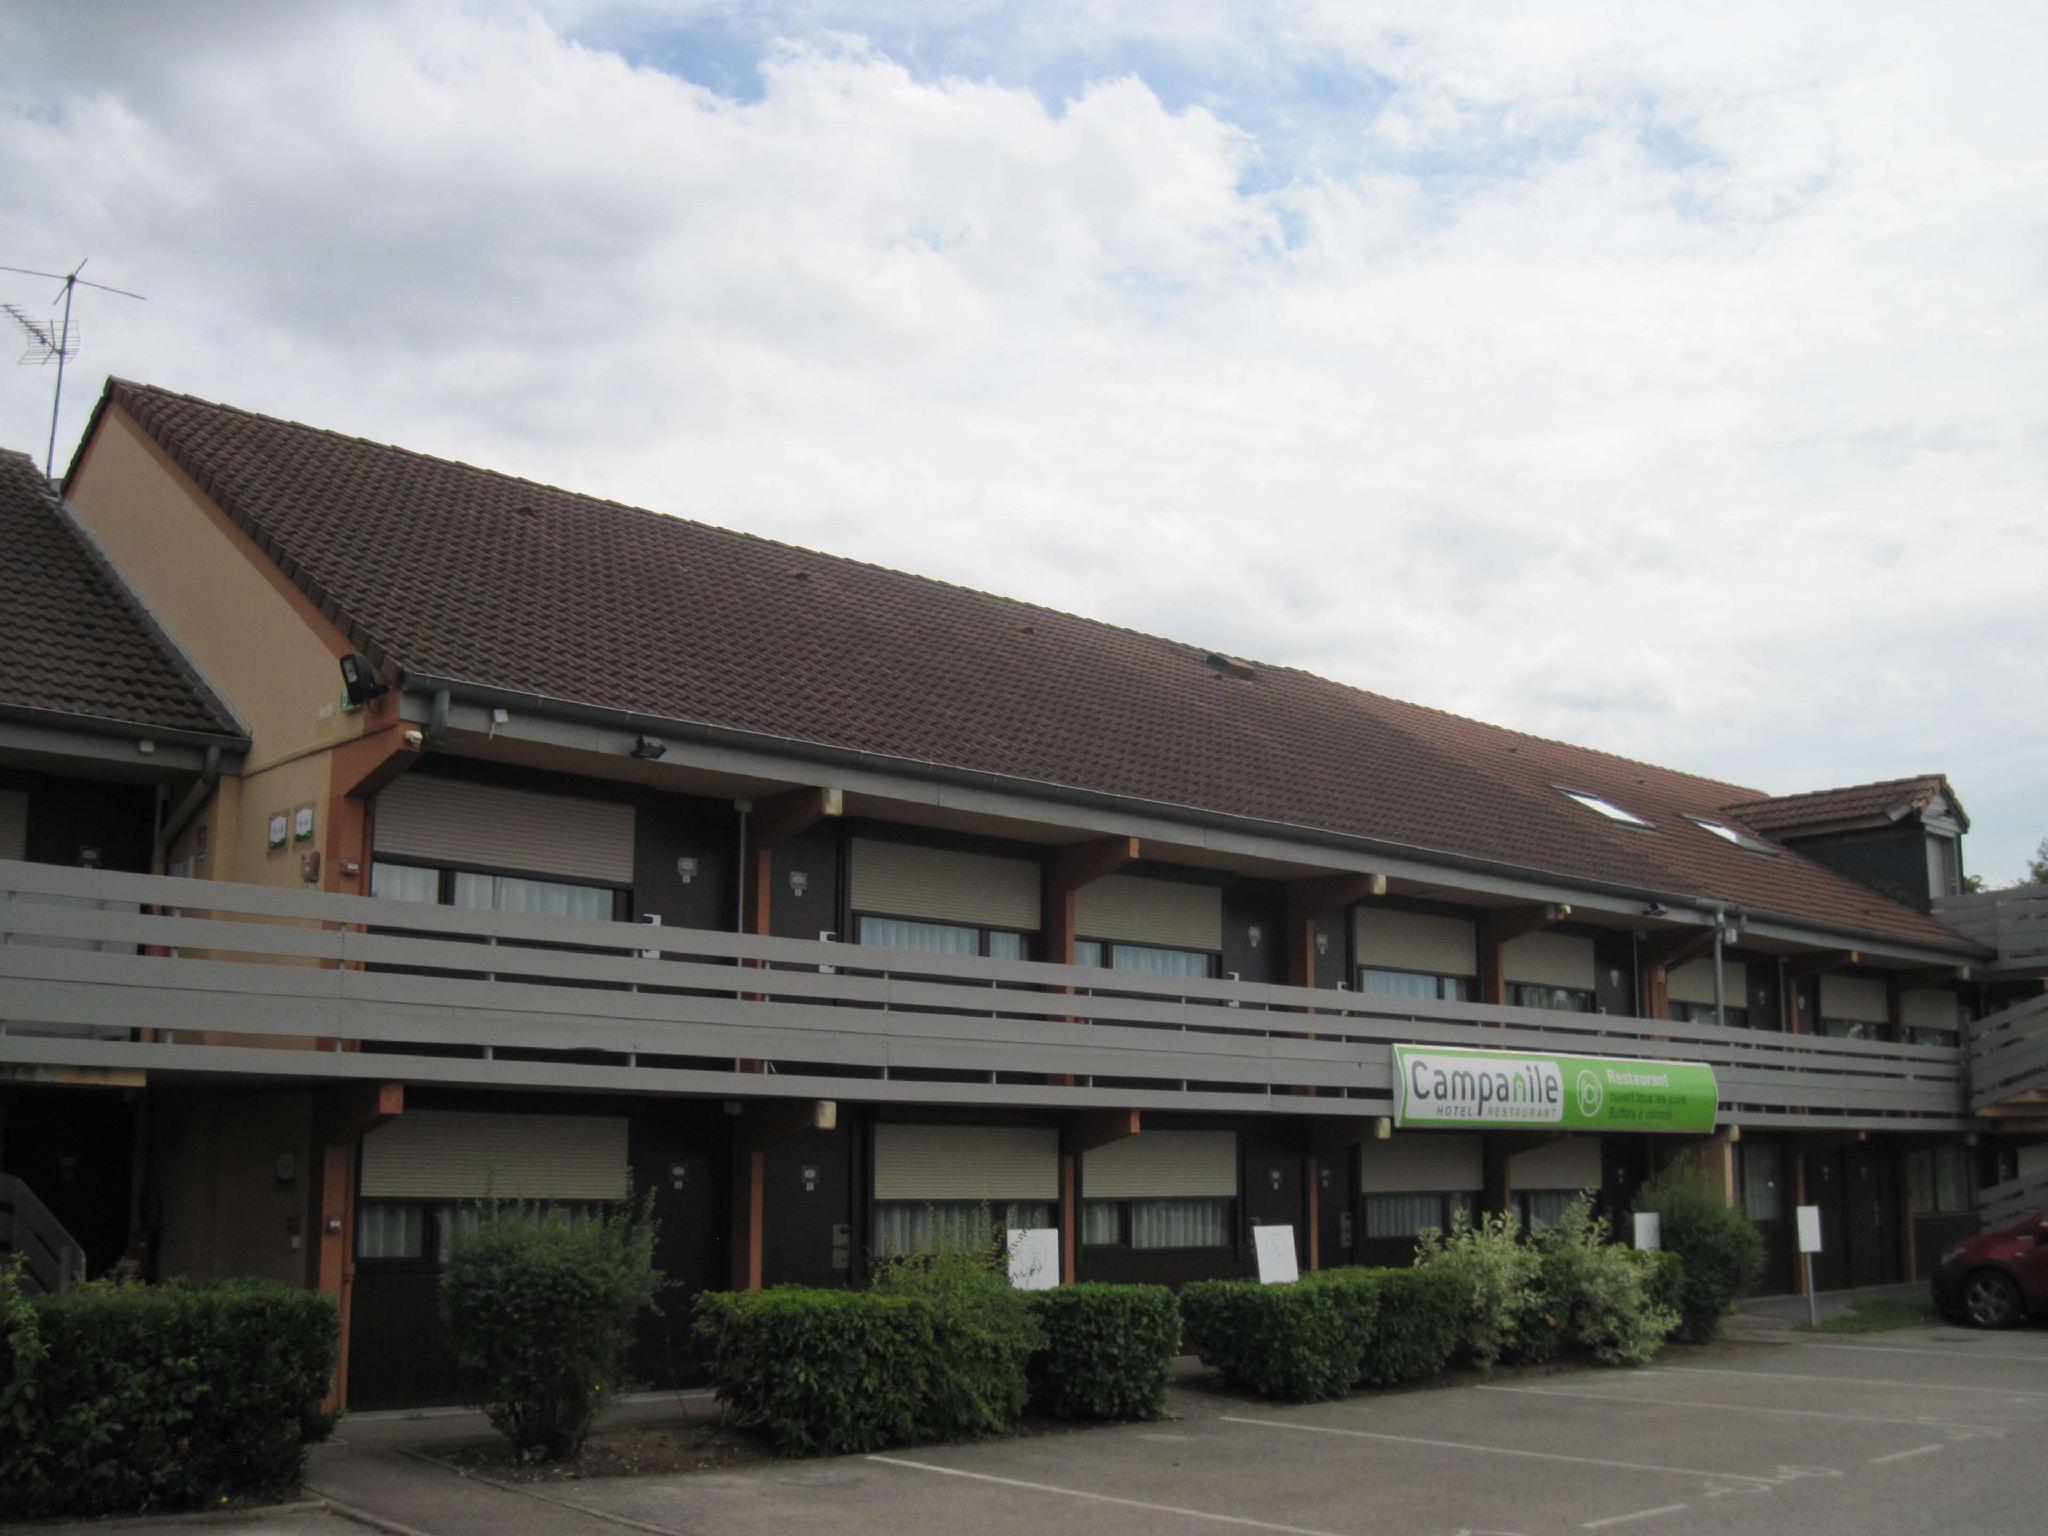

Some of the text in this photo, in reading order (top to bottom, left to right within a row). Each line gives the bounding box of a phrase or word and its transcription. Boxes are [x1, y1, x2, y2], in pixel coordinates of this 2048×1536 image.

[1606, 1069, 1671, 1088] Restaurant
[1411, 1060, 1558, 1117] Campanile
[1436, 1106, 1557, 1119] HOTEL RESTAURANT
